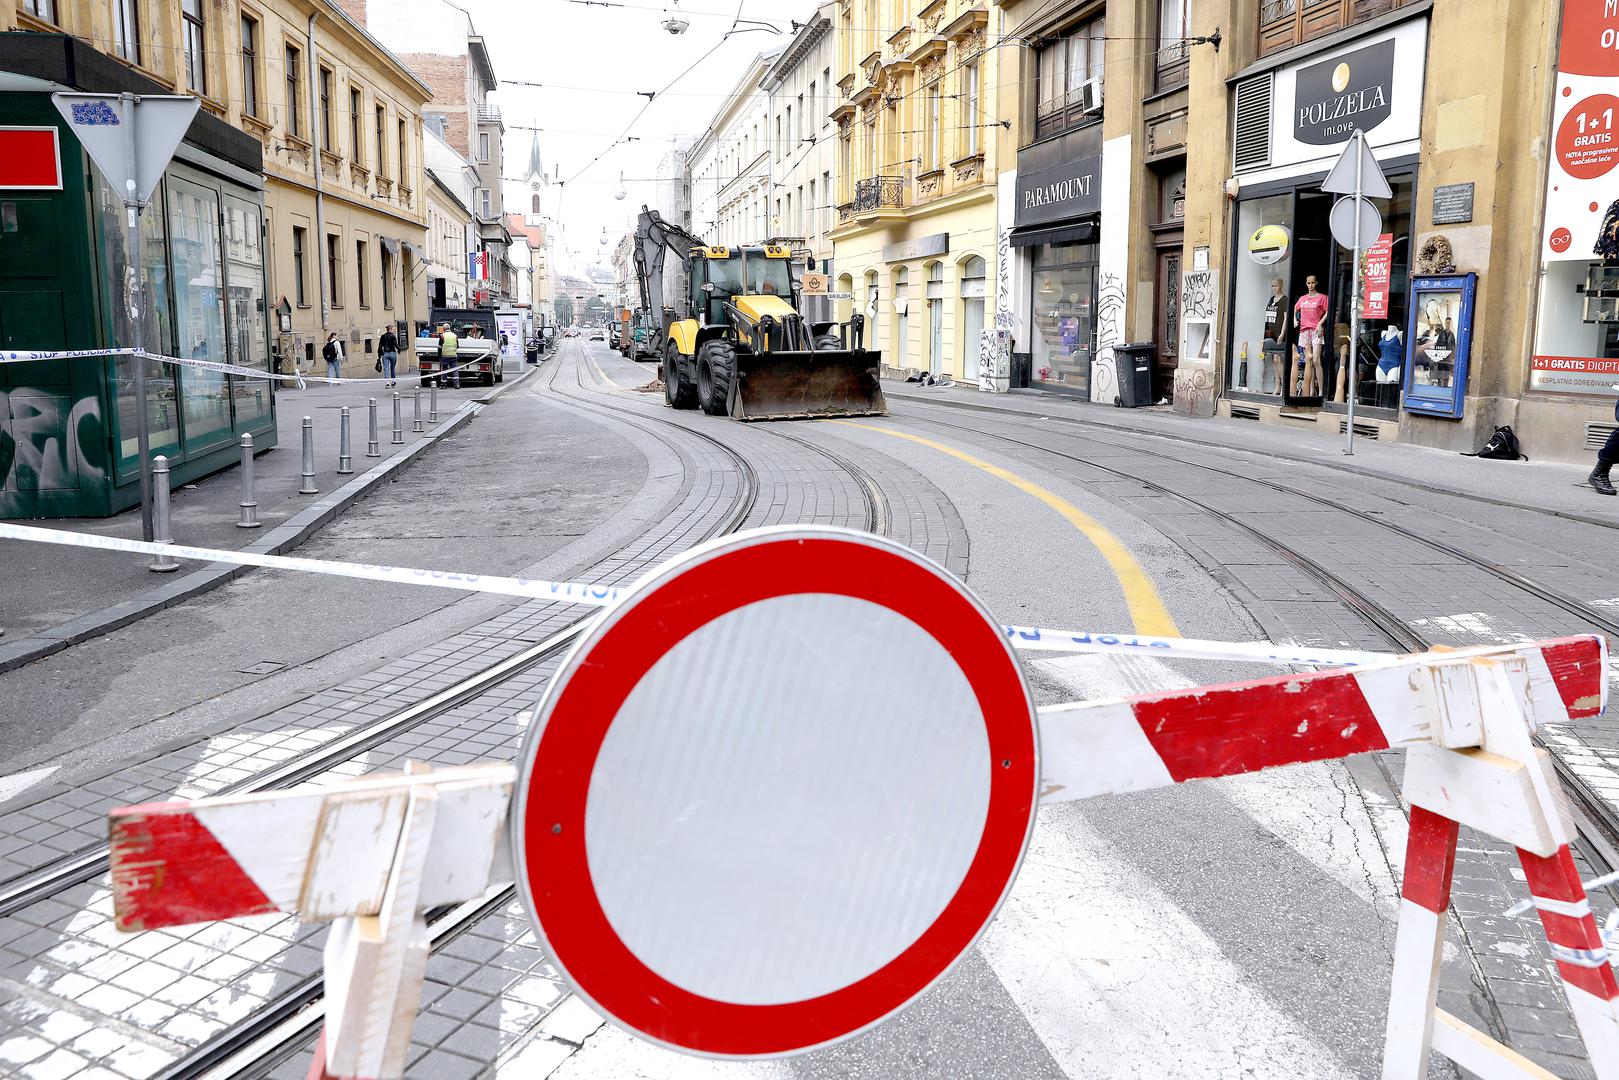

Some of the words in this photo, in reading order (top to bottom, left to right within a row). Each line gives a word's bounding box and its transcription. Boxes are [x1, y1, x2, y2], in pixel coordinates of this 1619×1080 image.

[1299, 82, 1386, 128] POLZELA
[1574, 132, 1612, 147] GRATIS
[1565, 151, 1582, 159] HOYA
[1582, 147, 1619, 157] progresivne
[1024, 174, 1093, 209] PARAMOUNT
[1533, 358, 1549, 368] 1+1
[1551, 359, 1585, 370] GRATIS
